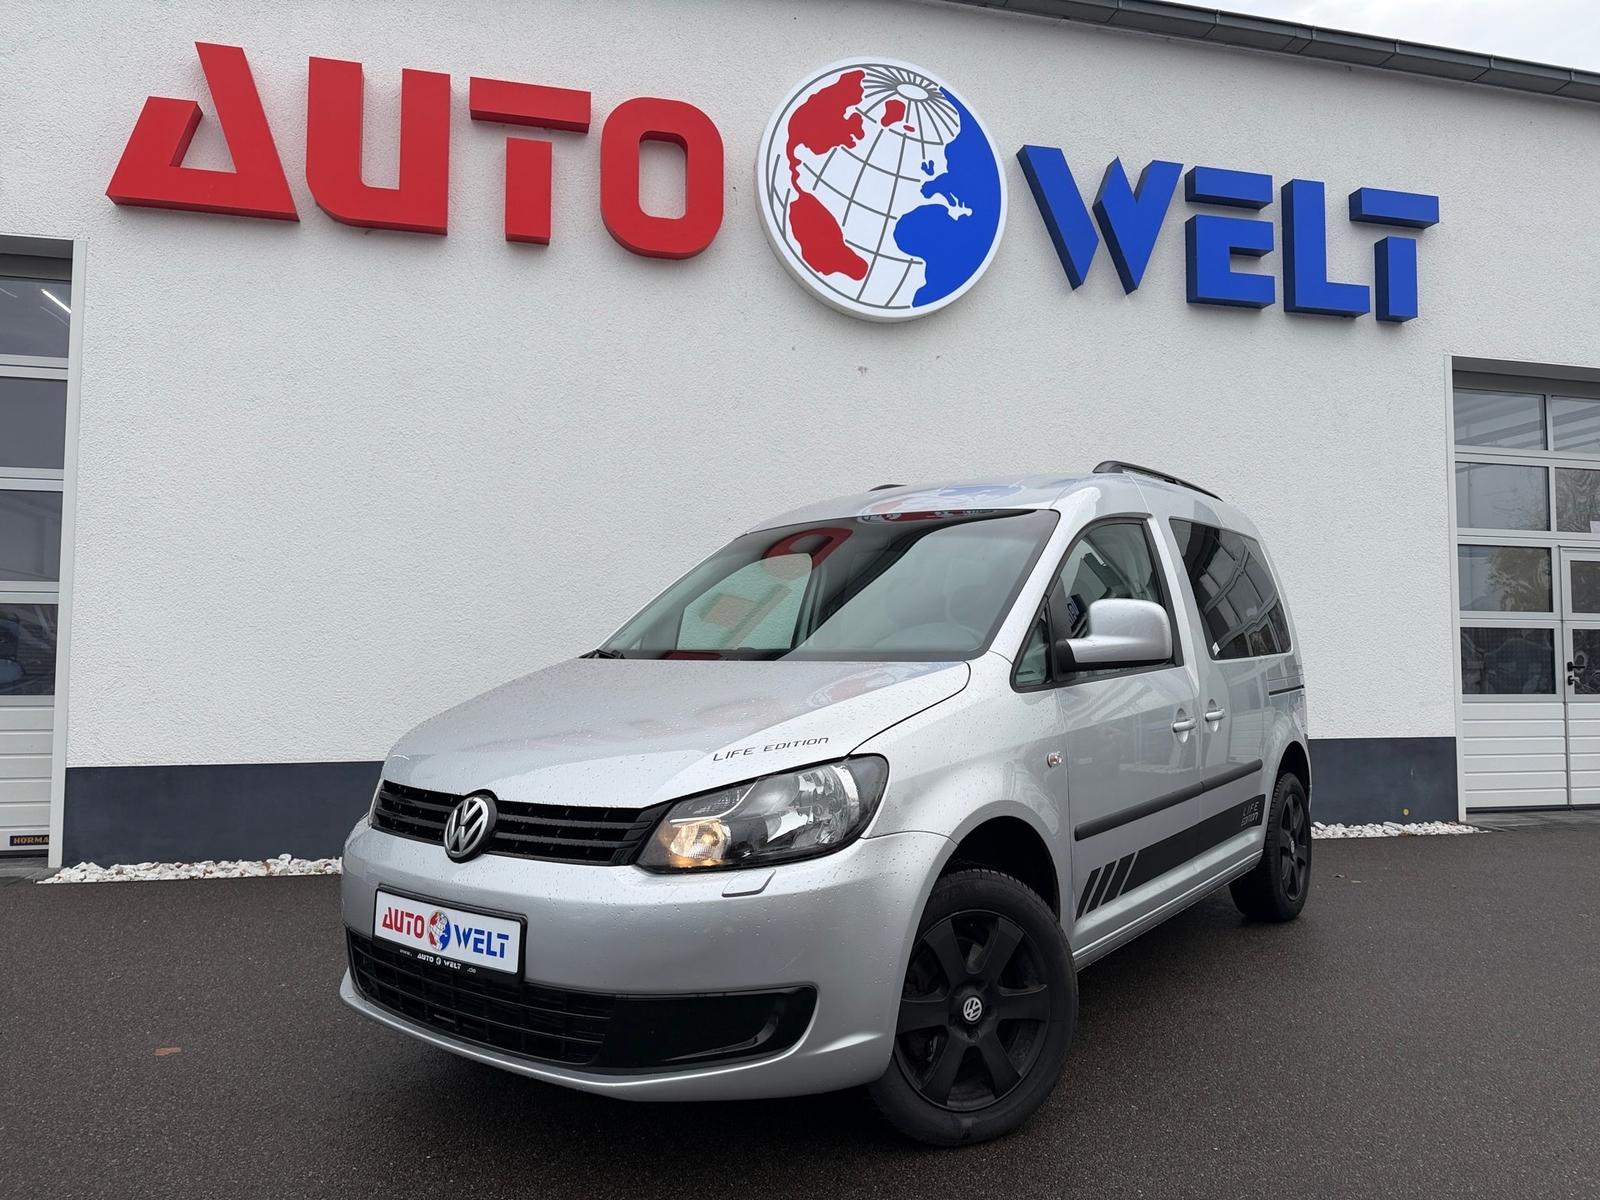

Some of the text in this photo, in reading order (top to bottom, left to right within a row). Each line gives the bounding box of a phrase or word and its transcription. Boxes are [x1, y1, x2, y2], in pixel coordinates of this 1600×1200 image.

[105, 42, 1440, 323] AUTO WELT
[713, 737, 829, 762] LIFE EDITION
[382, 907, 510, 959] AUTO WELT
[417, 953, 434, 963] AUTO
[443, 959, 462, 970] WELT
